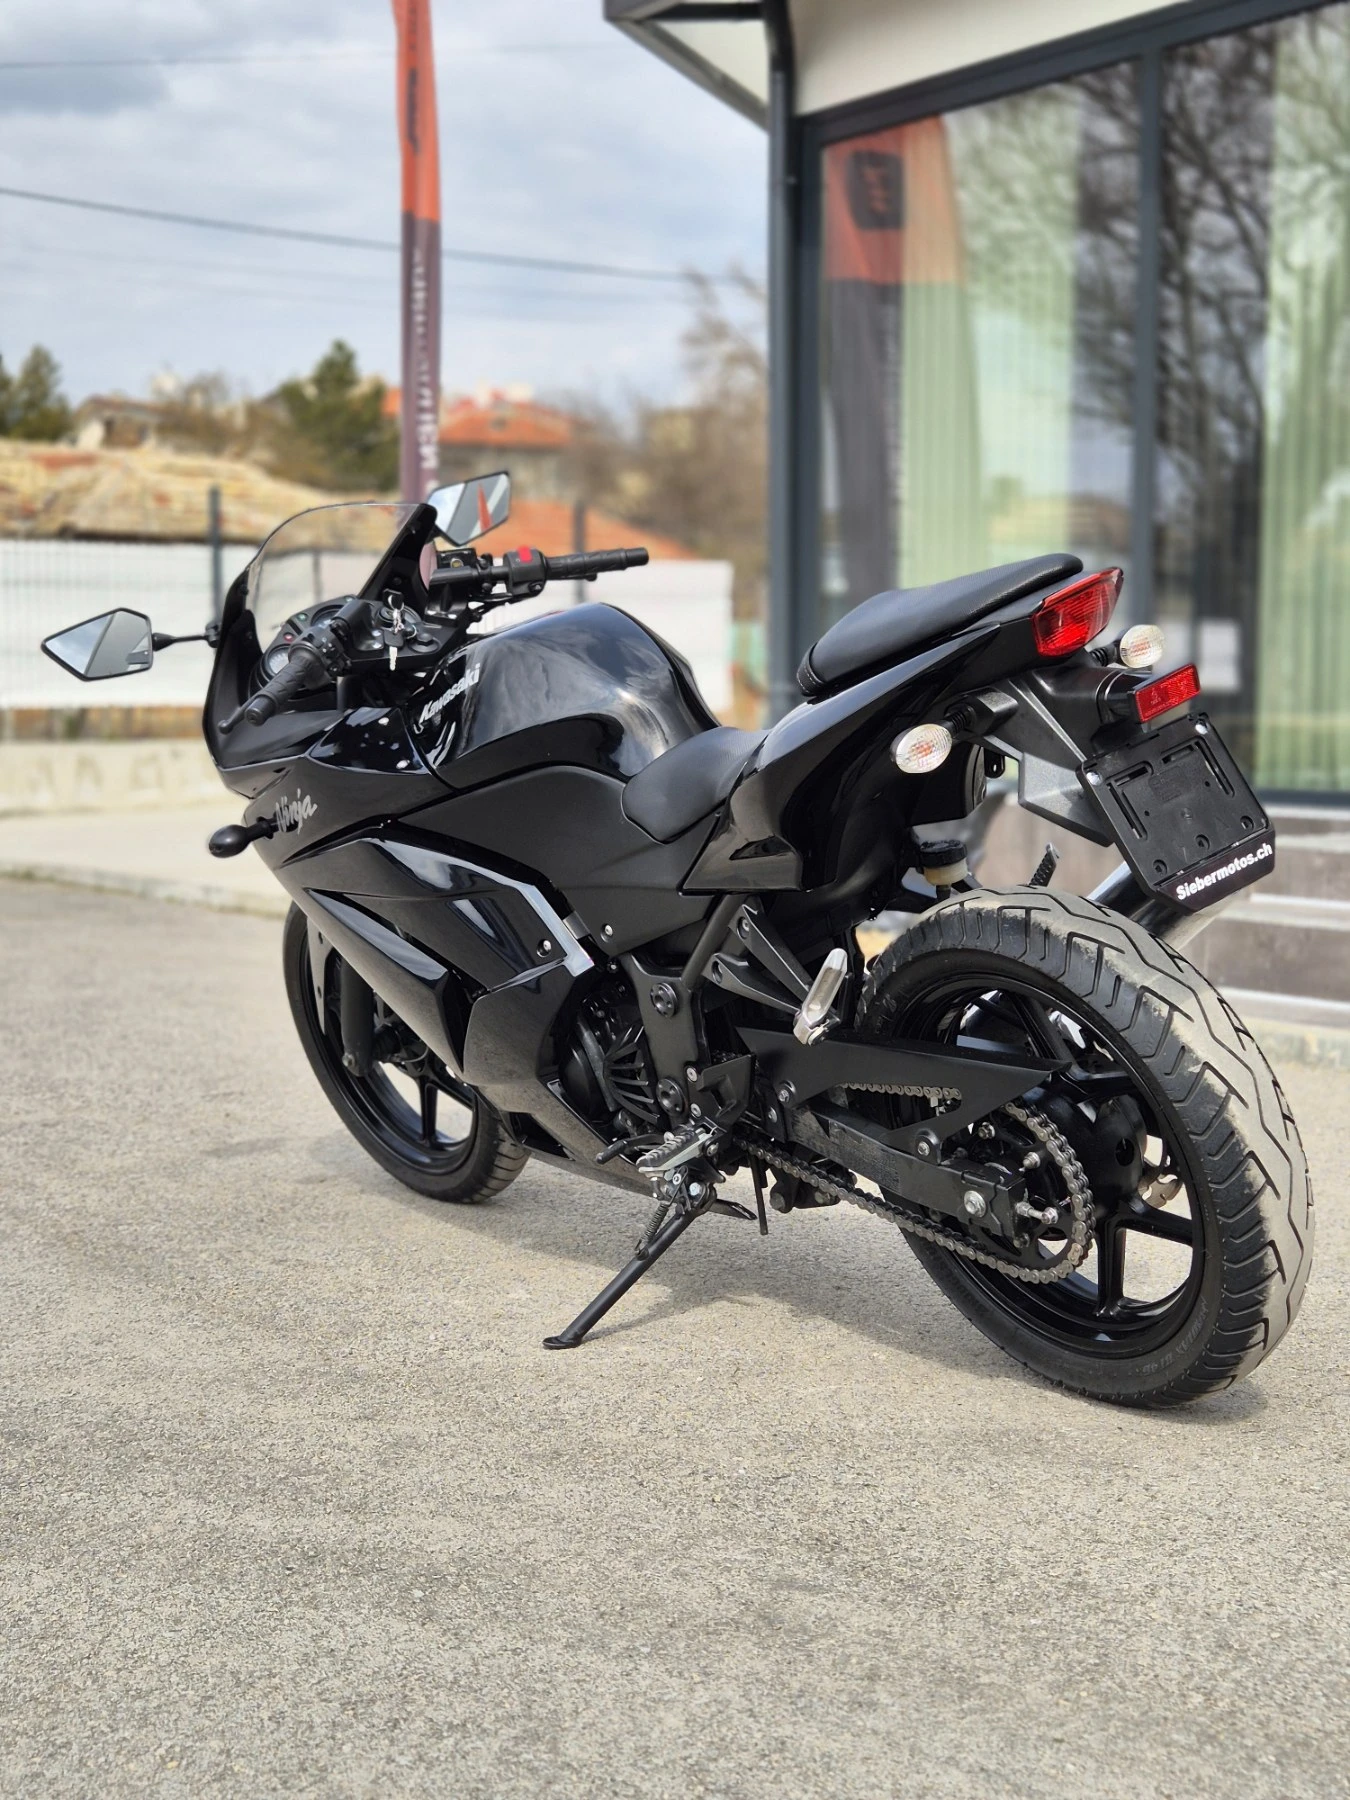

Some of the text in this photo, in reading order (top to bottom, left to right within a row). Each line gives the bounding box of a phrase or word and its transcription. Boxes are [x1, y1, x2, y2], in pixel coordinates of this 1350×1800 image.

[418, 663, 480, 724] Kawasaki
[275, 788, 318, 835] Ninja
[1176, 843, 1273, 900] Siebermotos.ch
